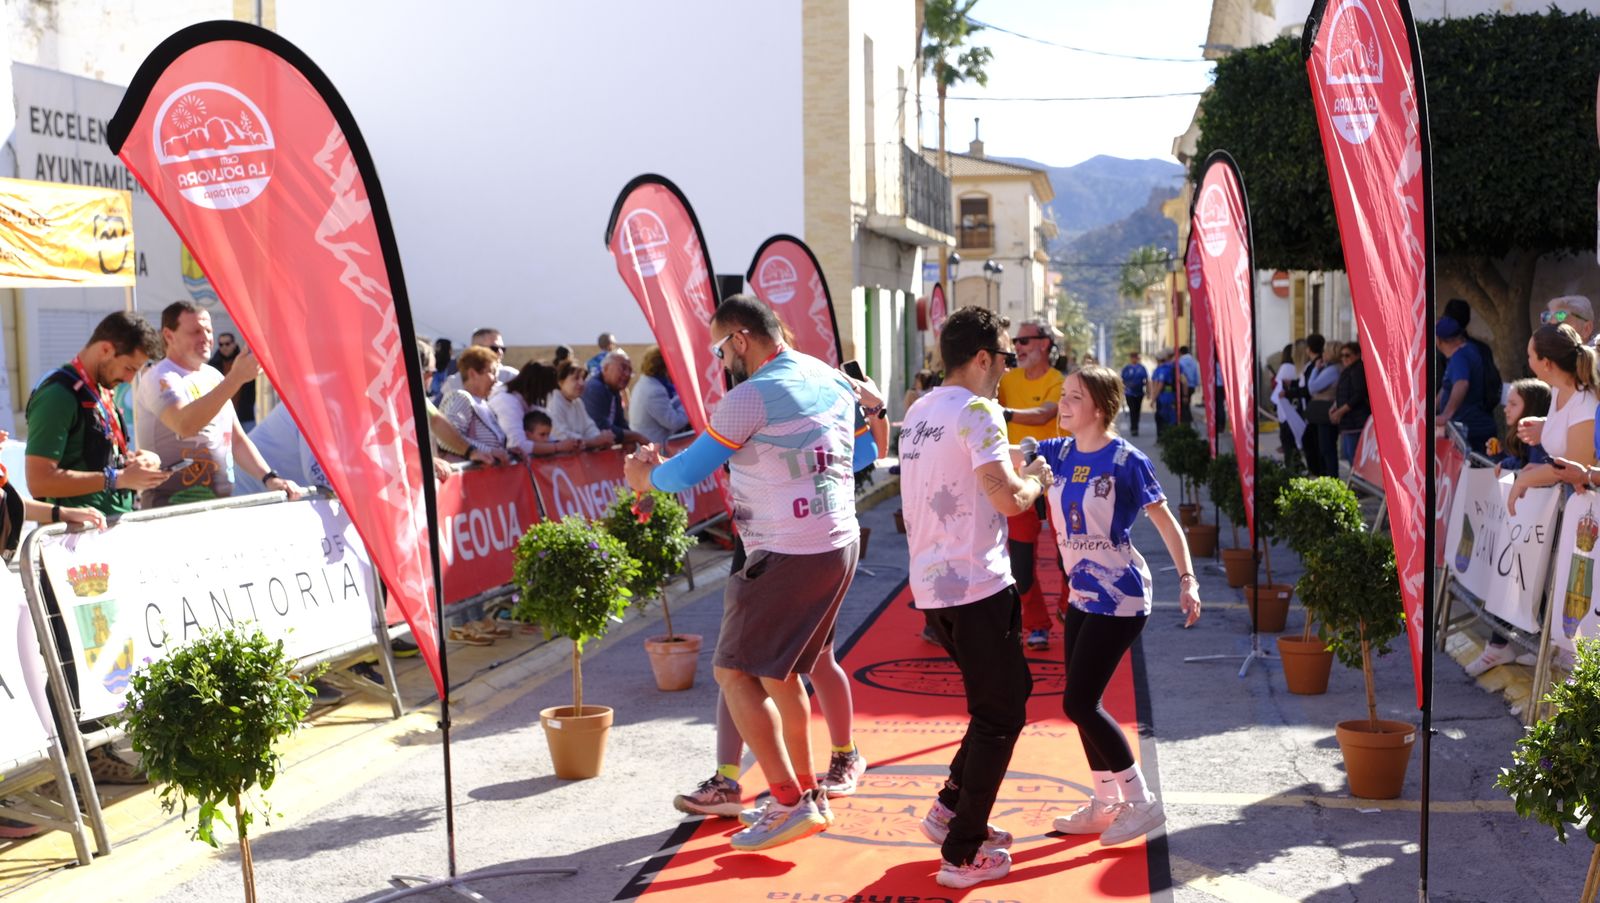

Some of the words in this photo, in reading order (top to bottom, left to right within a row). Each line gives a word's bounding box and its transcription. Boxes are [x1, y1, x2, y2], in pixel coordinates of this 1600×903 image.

[29, 105, 109, 147] EXCELEN
[1071, 465, 1091, 483] 22
[321, 534, 345, 557] DE
[437, 501, 523, 567] VEOLIA
[145, 562, 360, 649] CANTORIA
